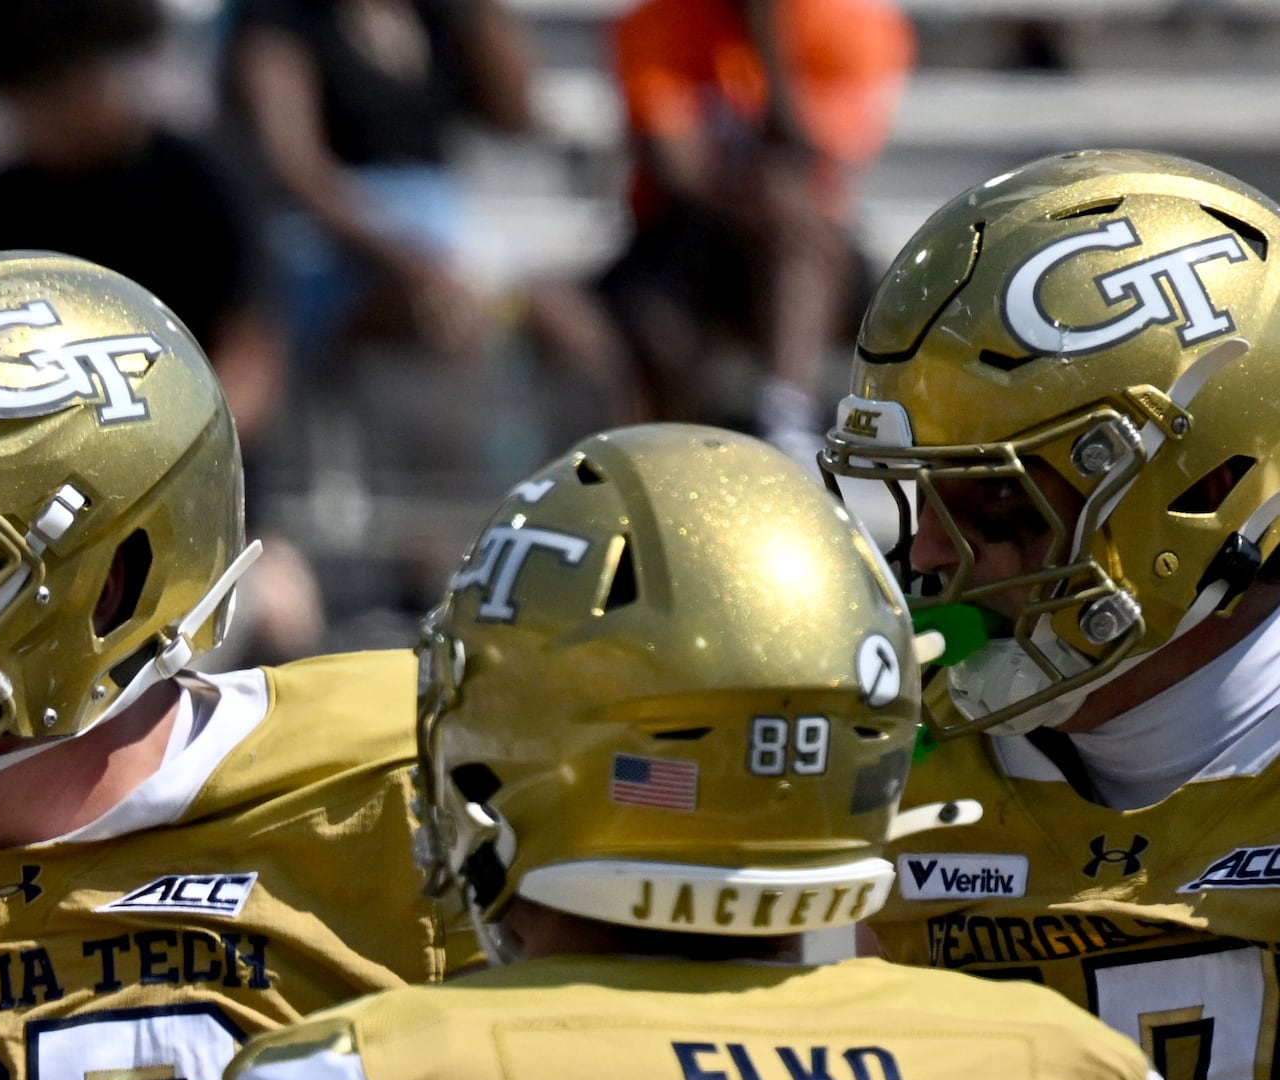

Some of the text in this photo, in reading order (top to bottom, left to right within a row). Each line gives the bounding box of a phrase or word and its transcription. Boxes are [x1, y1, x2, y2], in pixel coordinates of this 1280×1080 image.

[1000, 217, 1248, 358] GT
[748, 715, 831, 777] 89
[122, 873, 252, 905] ACC
[632, 879, 875, 926] JACKETS
[82, 929, 272, 993] TECH
